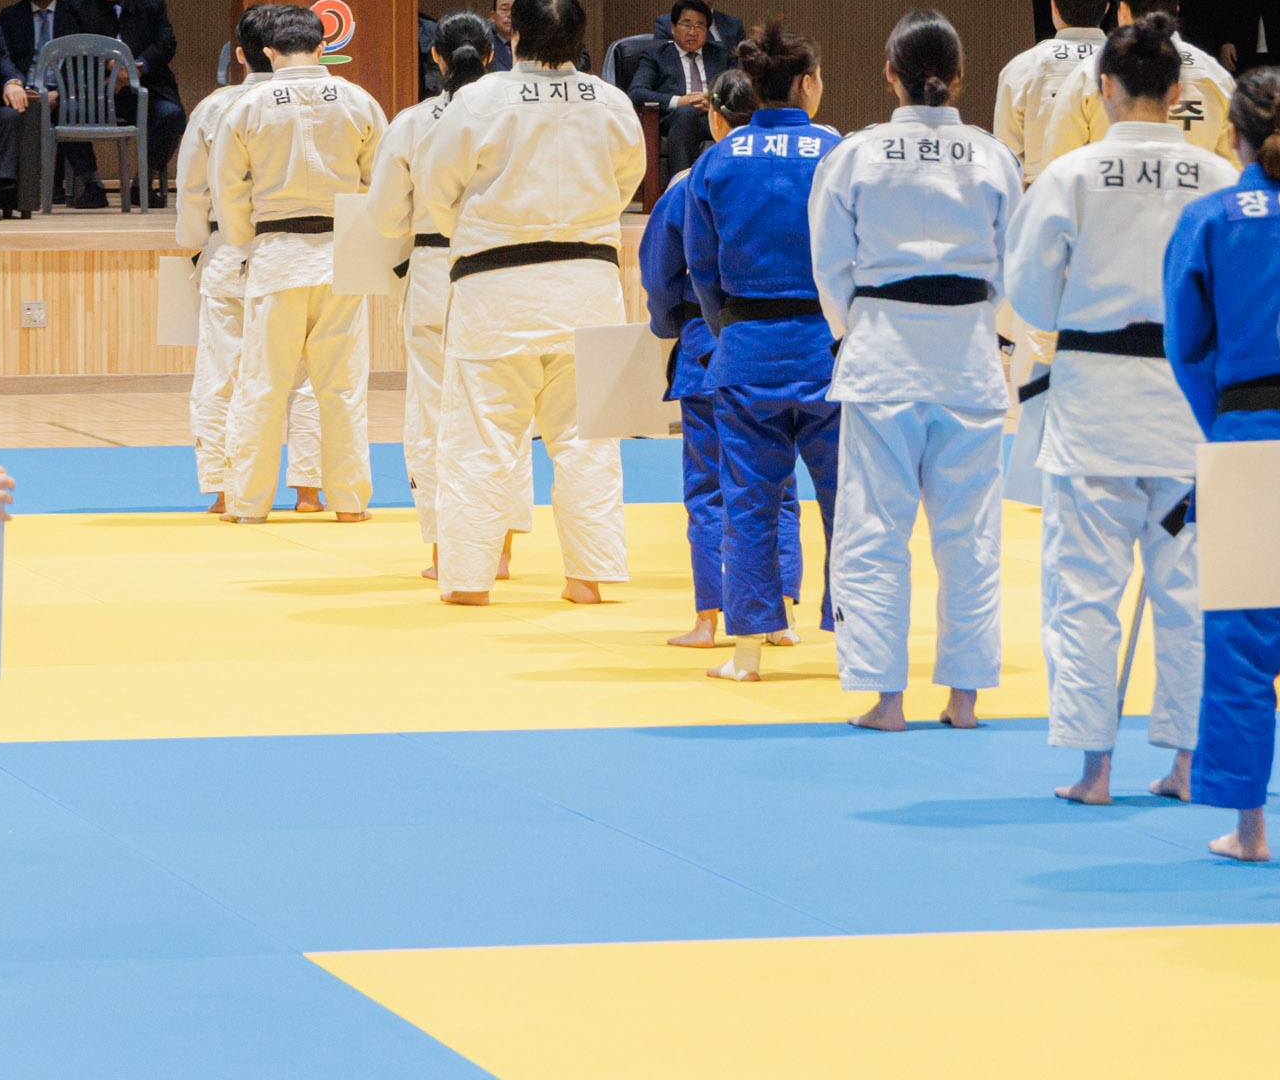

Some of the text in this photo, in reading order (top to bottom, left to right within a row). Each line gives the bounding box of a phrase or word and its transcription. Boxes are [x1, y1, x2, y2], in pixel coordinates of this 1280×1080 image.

[273, 85, 338, 106] 임성
[519, 81, 596, 102] 신지영
[730, 133, 820, 158] 김재령
[884, 138, 973, 162] 김현아
[1100, 159, 1199, 190] 김서연
